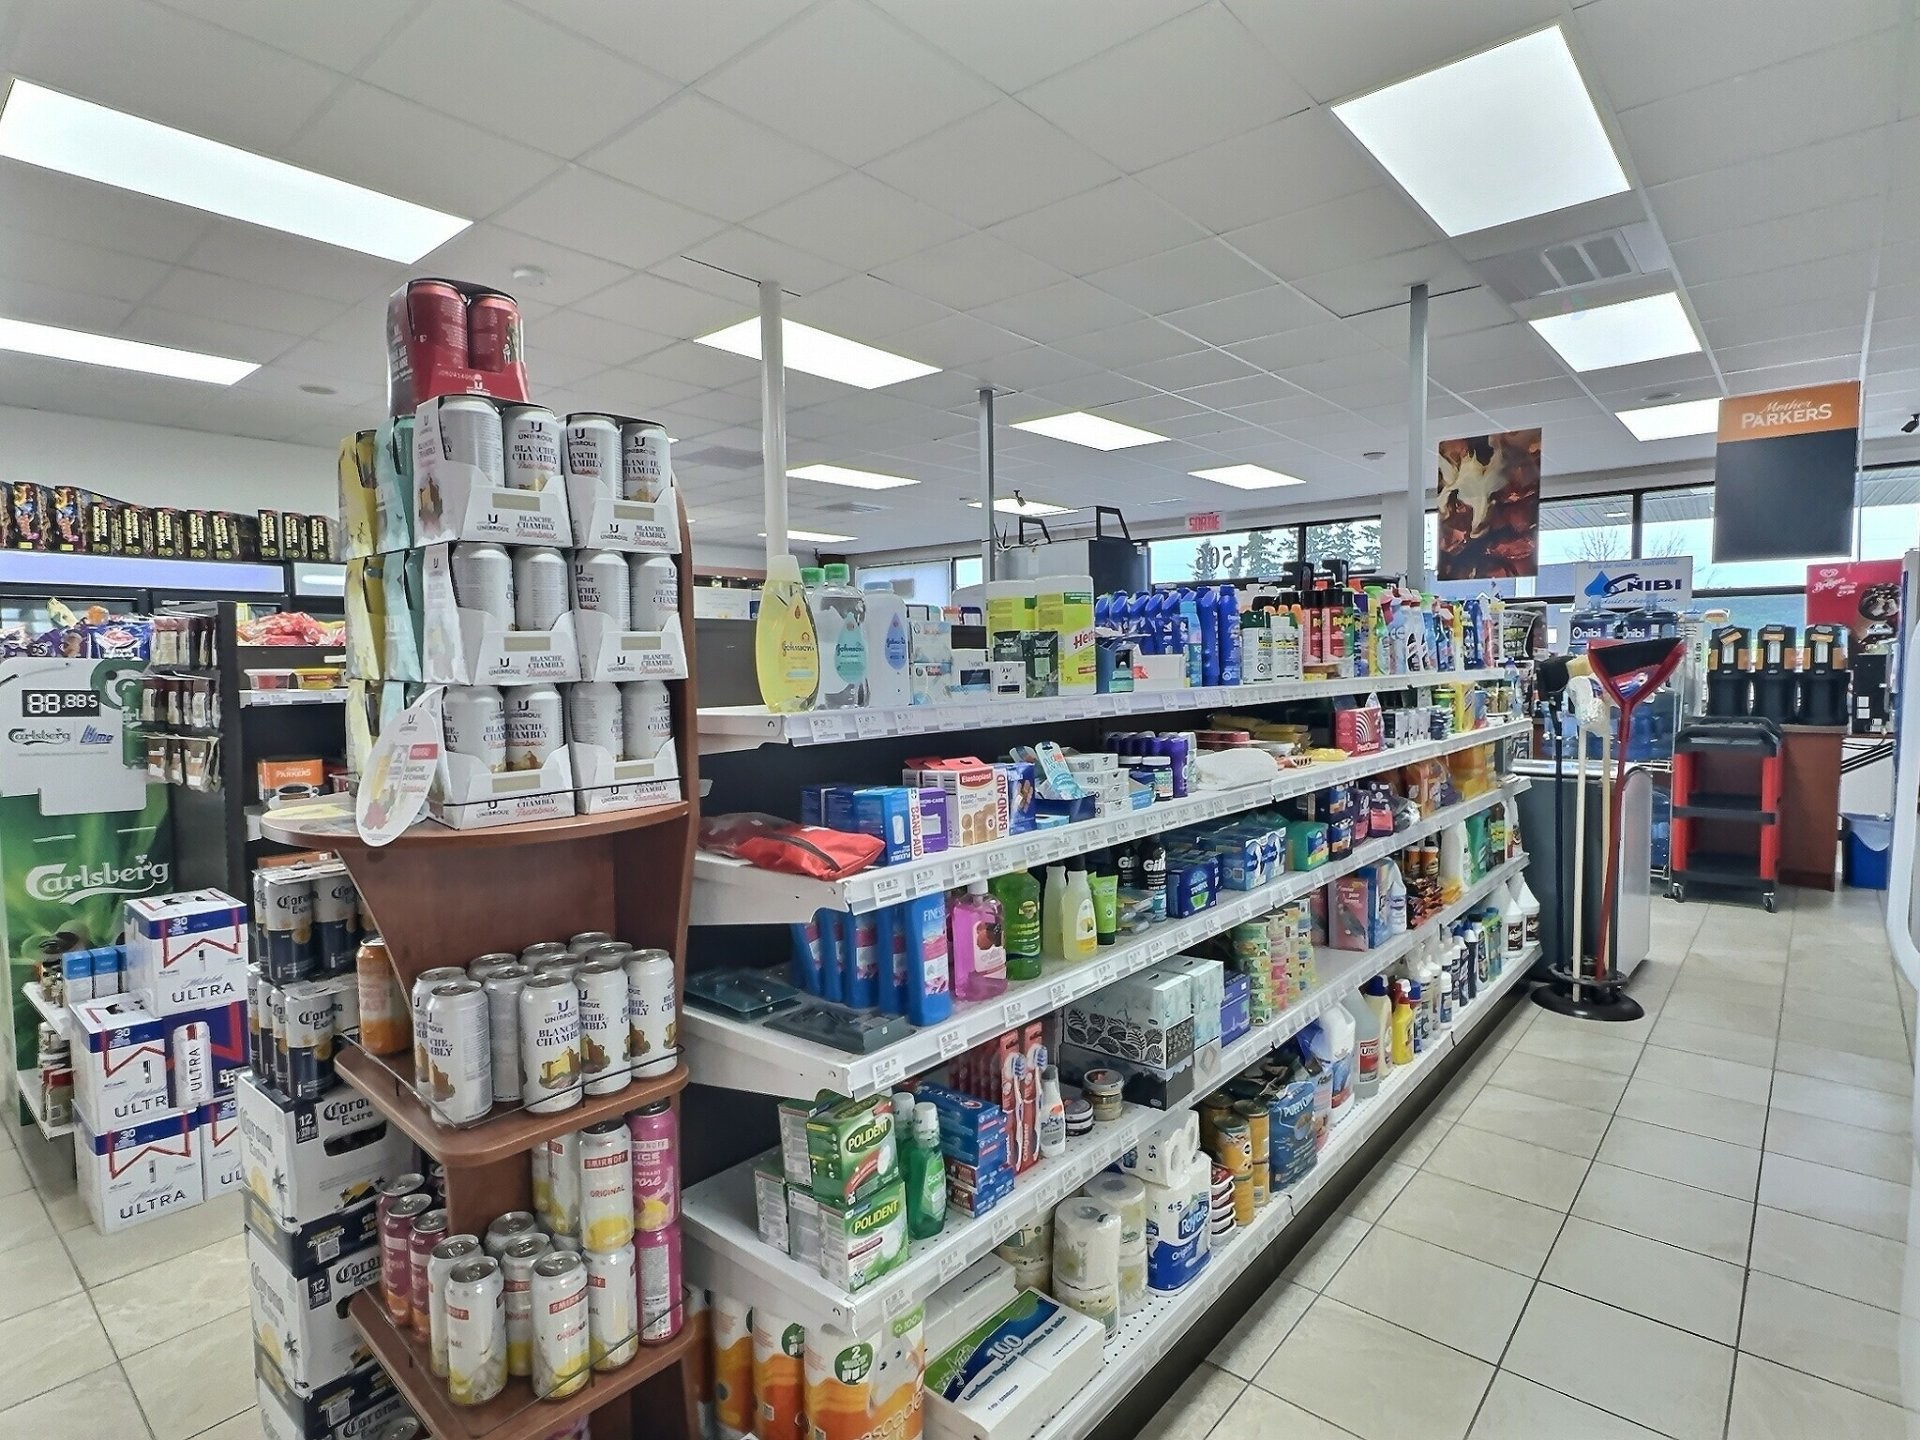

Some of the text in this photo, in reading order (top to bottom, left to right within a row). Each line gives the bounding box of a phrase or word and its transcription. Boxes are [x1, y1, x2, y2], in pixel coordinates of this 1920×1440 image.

[1741, 403, 1832, 429] PARKERS
[1760, 399, 1812, 414] Mother
[1188, 514, 1221, 532] SORTIE
[997, 774, 1008, 831] BAND-AID
[910, 806, 921, 857] BAND-AID
[25, 855, 169, 905] Carlsberg
[171, 982, 235, 1003] ULTRA
[189, 1047, 202, 1092] ULTRA
[114, 1095, 168, 1118] ULTR
[300, 1113, 313, 1127] 12
[848, 1119, 889, 1151] POLIDENT
[120, 1189, 187, 1220] ULTRA
[854, 1200, 899, 1234] POLIDENT
[851, 1346, 860, 1358] 2
[986, 1335, 1023, 1361] 100
